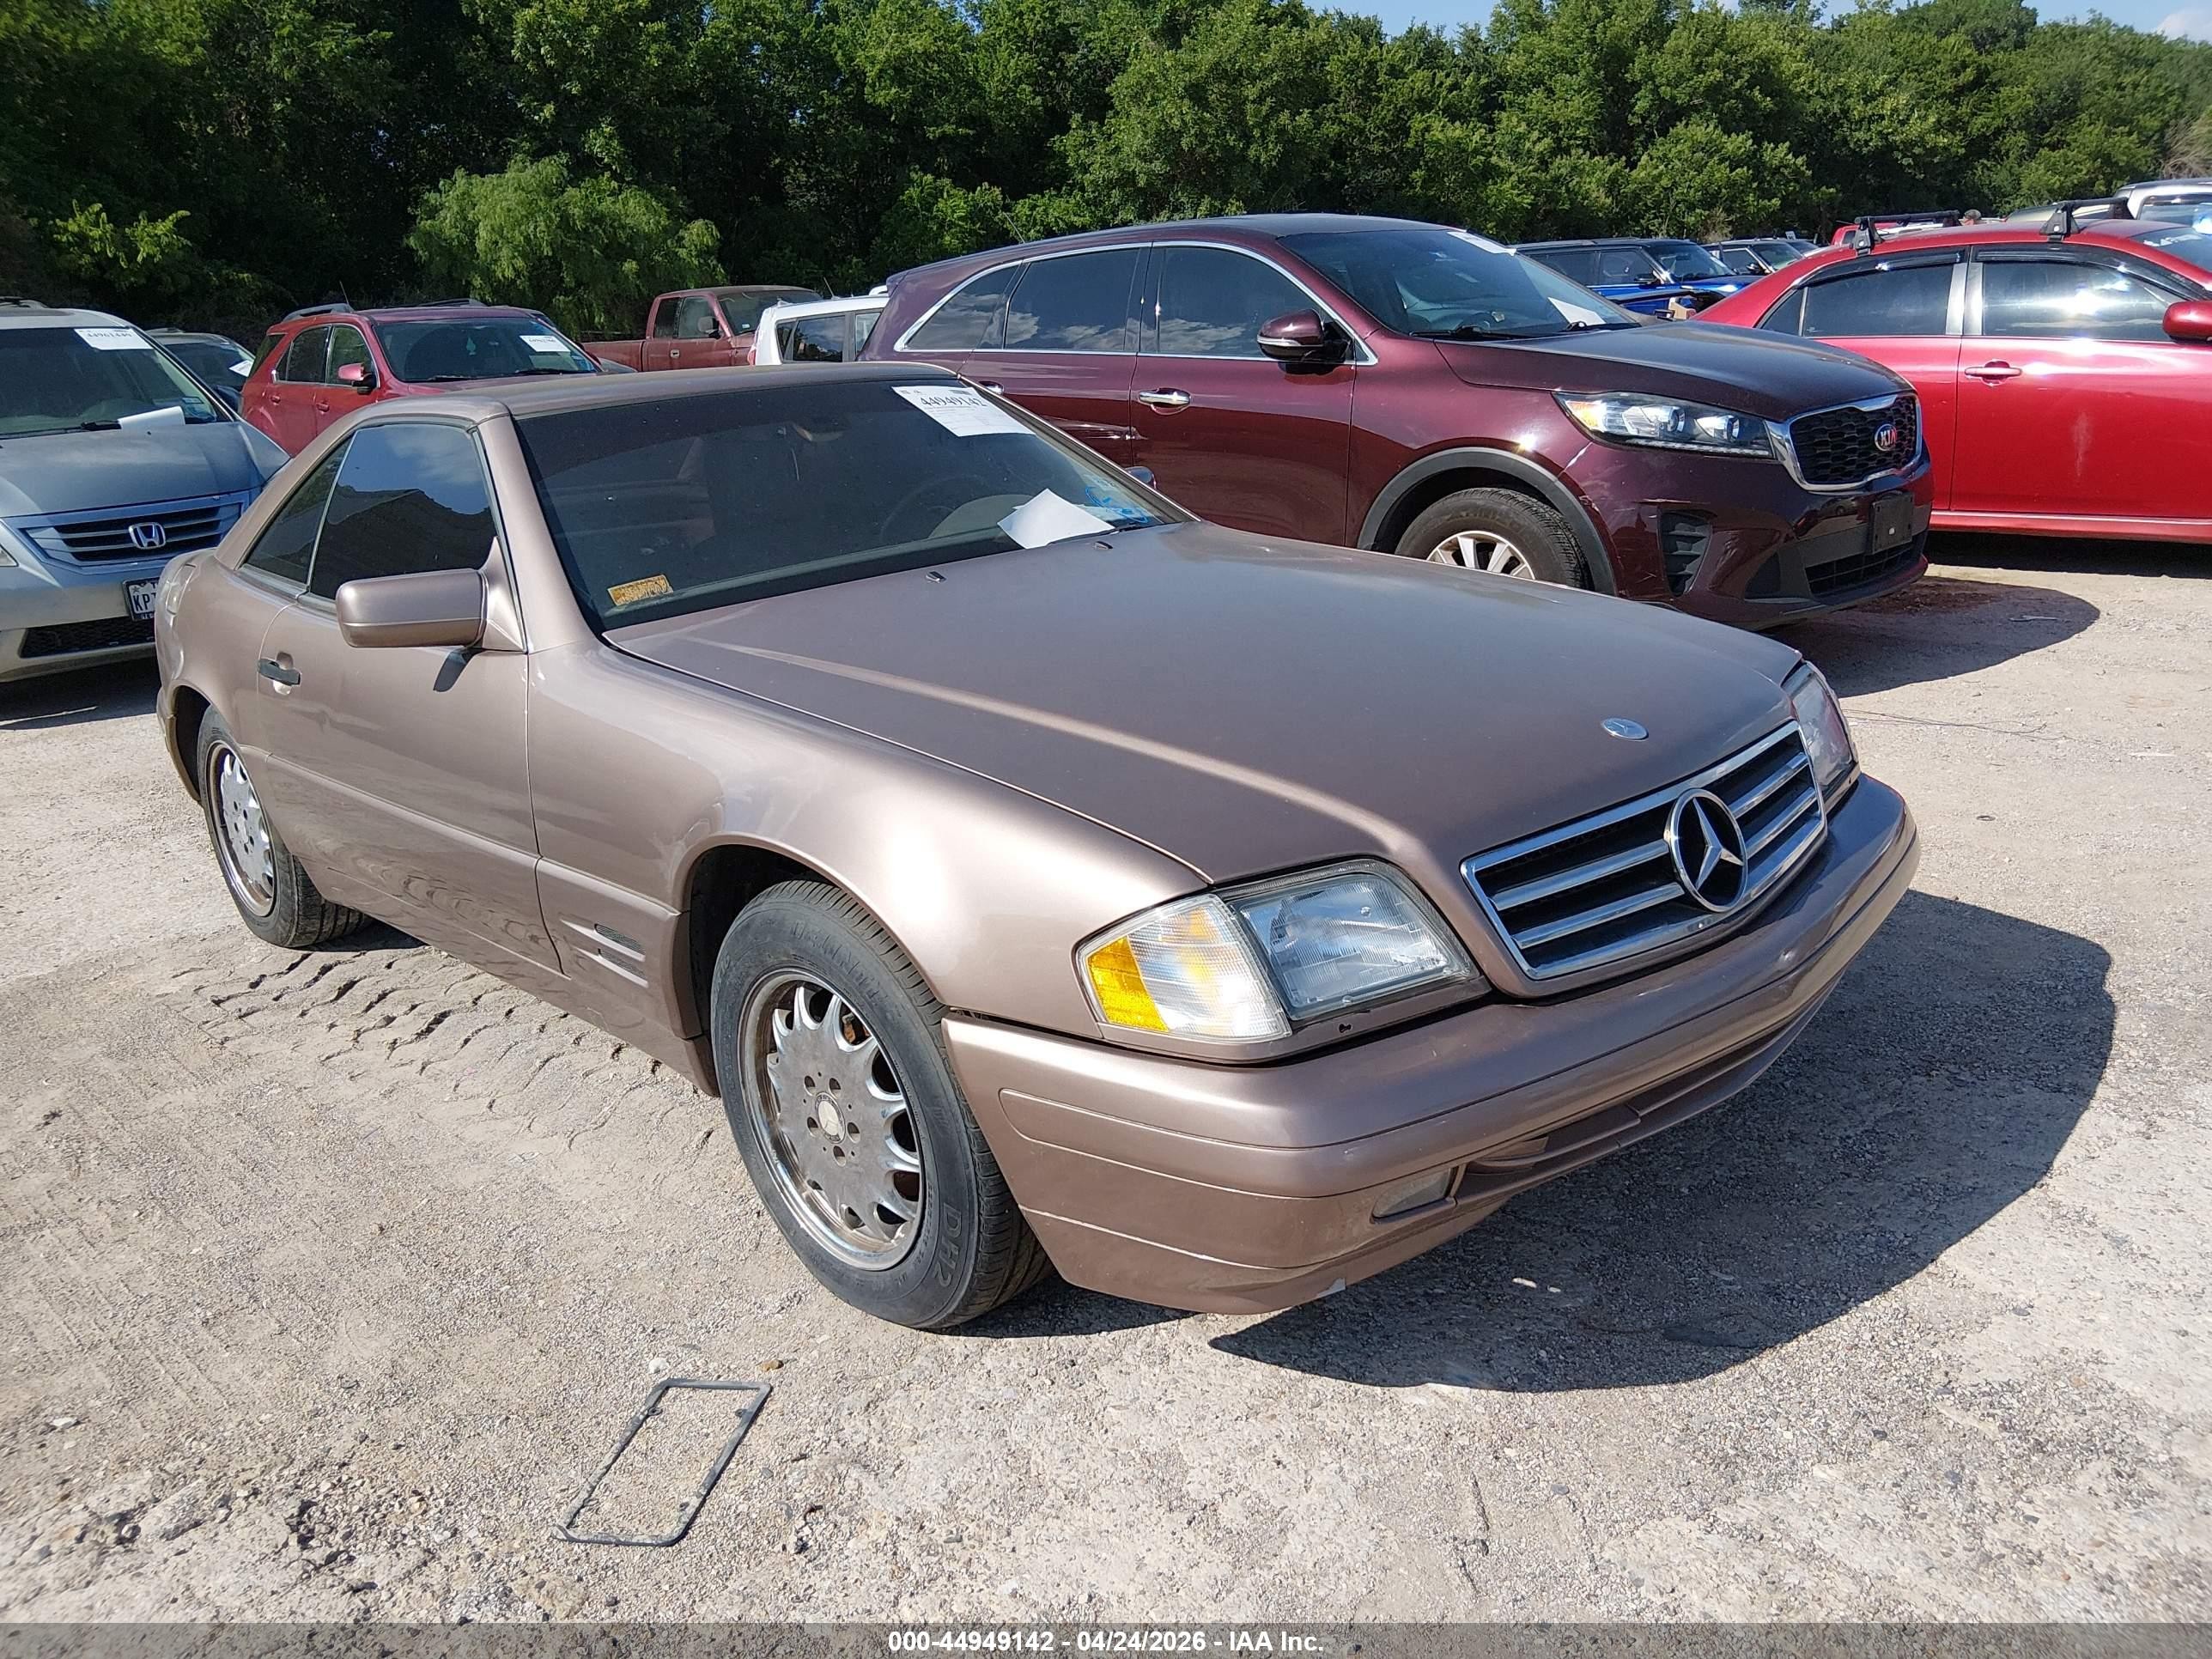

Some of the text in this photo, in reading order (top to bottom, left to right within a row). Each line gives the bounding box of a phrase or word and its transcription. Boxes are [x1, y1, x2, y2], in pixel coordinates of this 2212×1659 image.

[920, 396, 988, 407] 44949142
[1881, 428, 1896, 447] KIA
[933, 1202, 963, 1288] DH2
